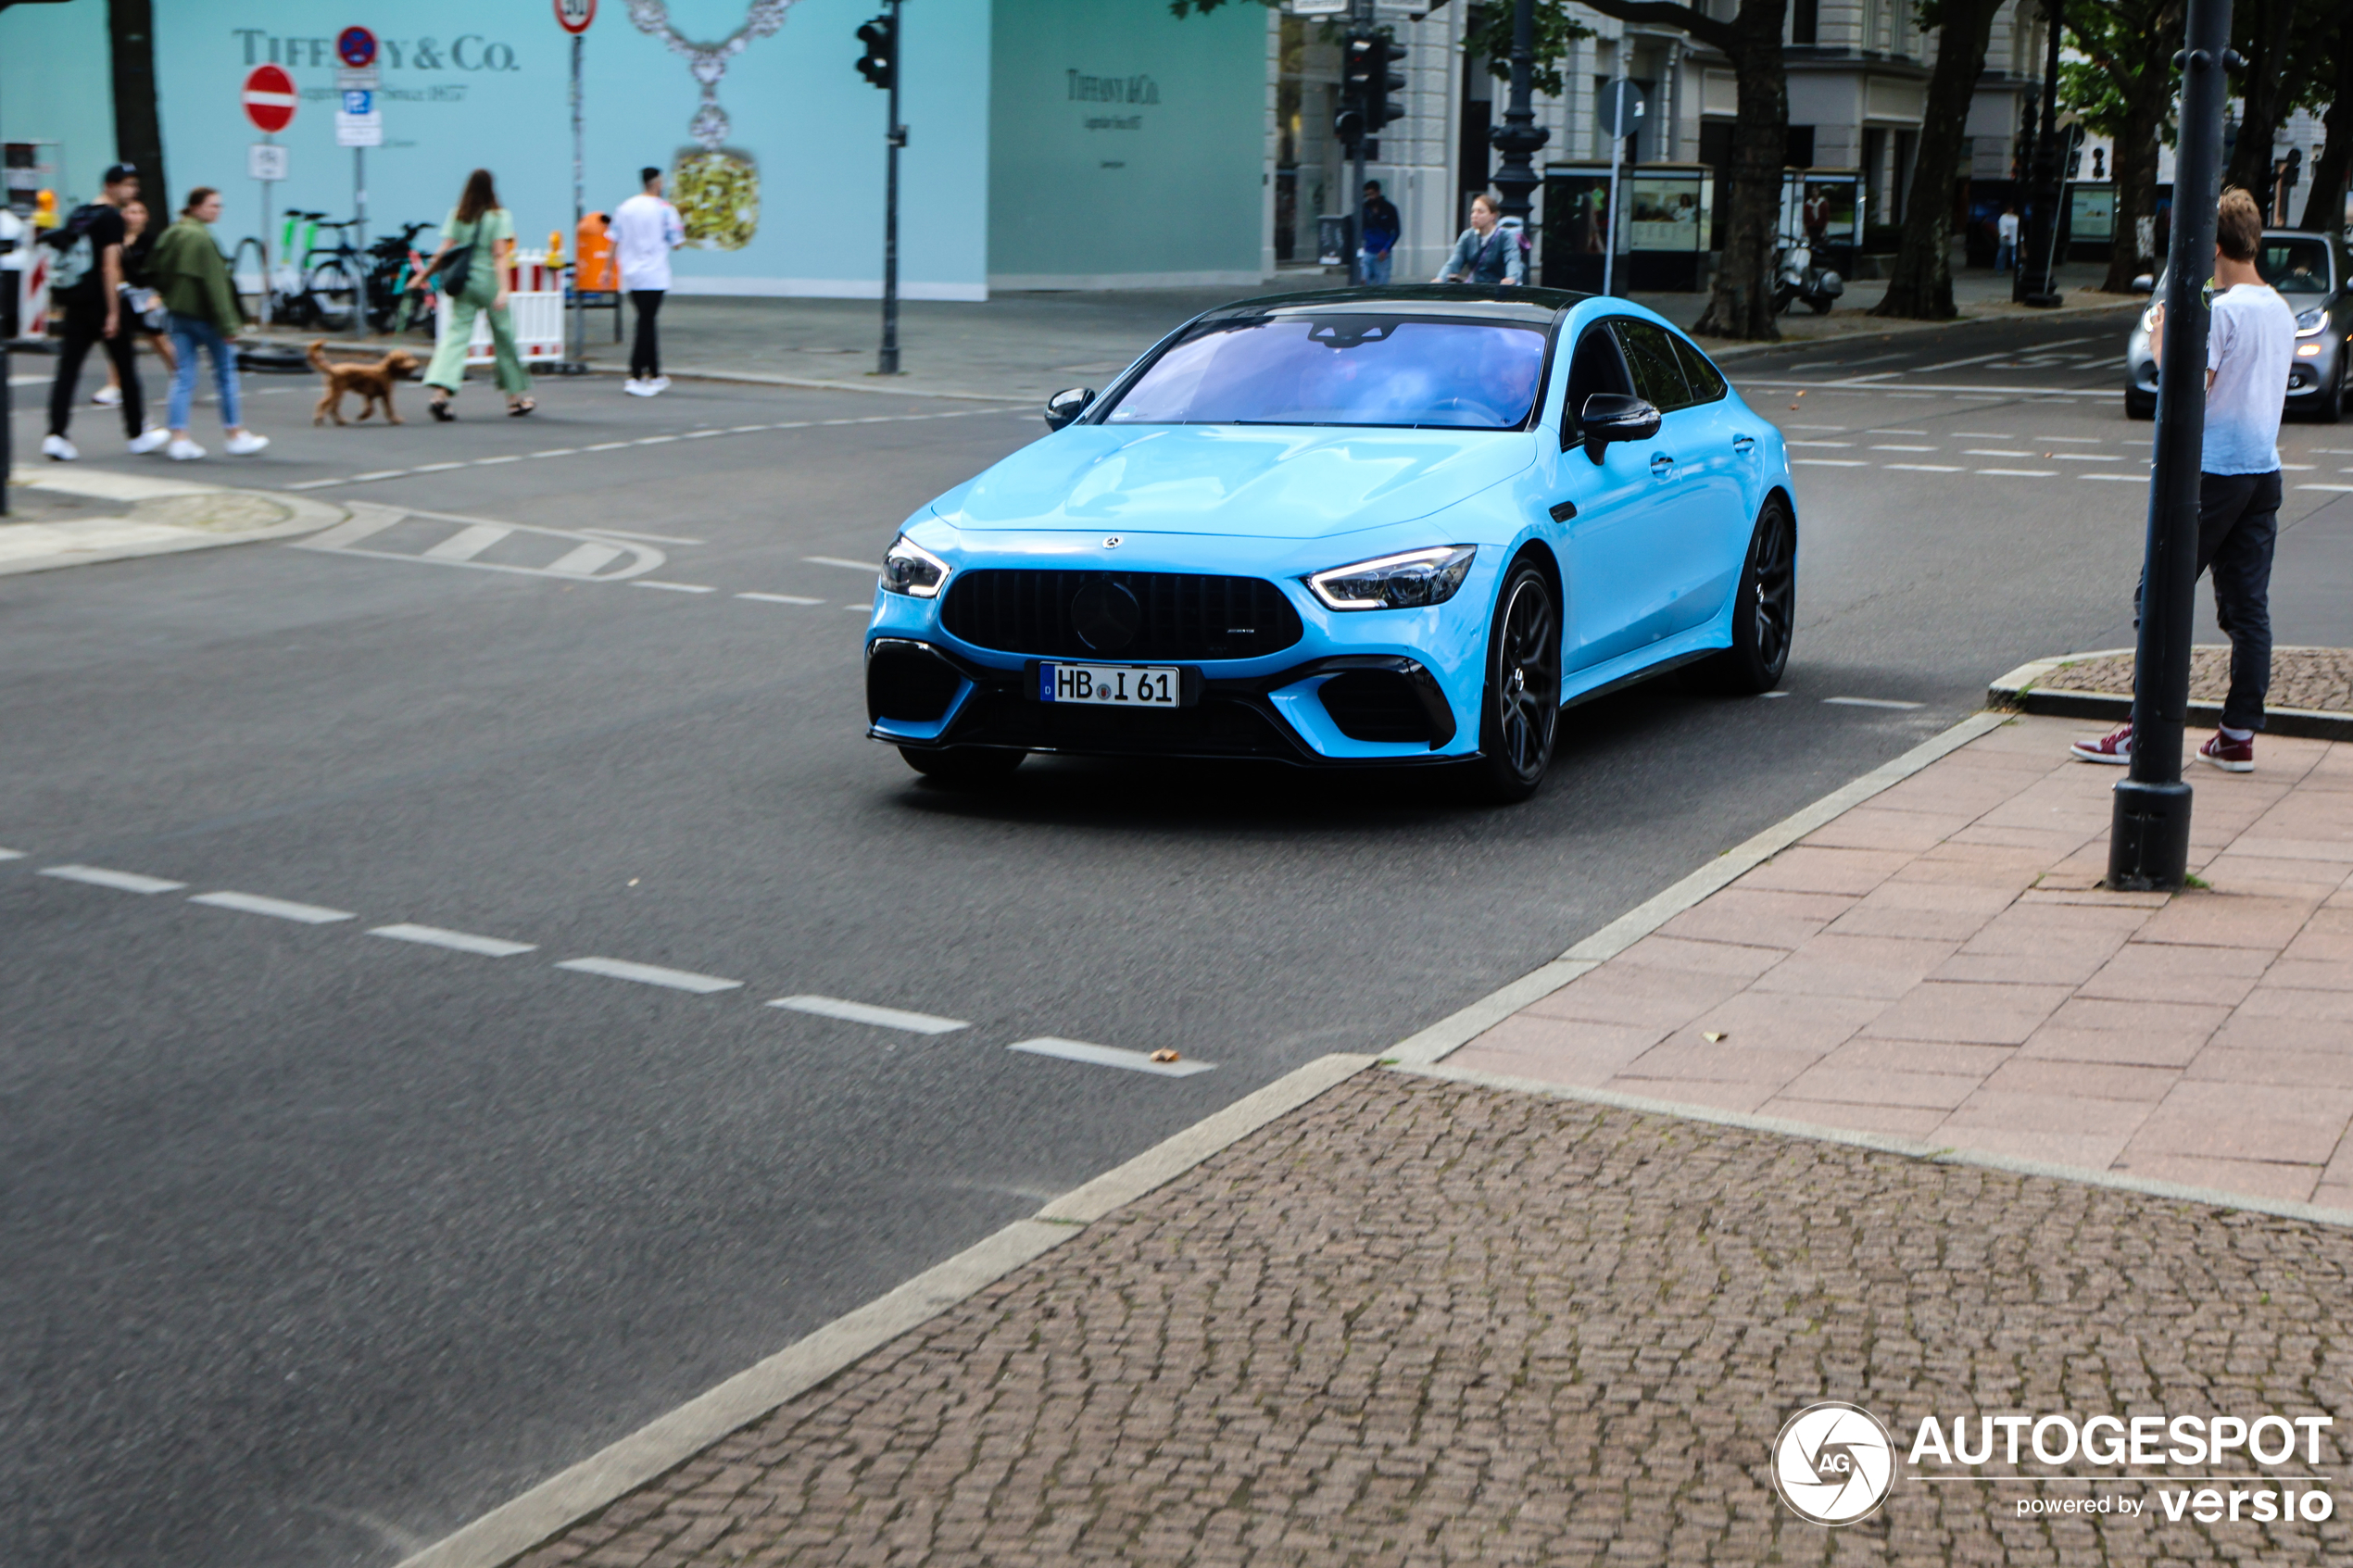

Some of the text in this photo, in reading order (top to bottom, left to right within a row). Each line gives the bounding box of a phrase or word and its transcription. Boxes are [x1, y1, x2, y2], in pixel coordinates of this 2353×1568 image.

[1044, 685, 1051, 695] D
[1057, 669, 1173, 702] HB I 61
